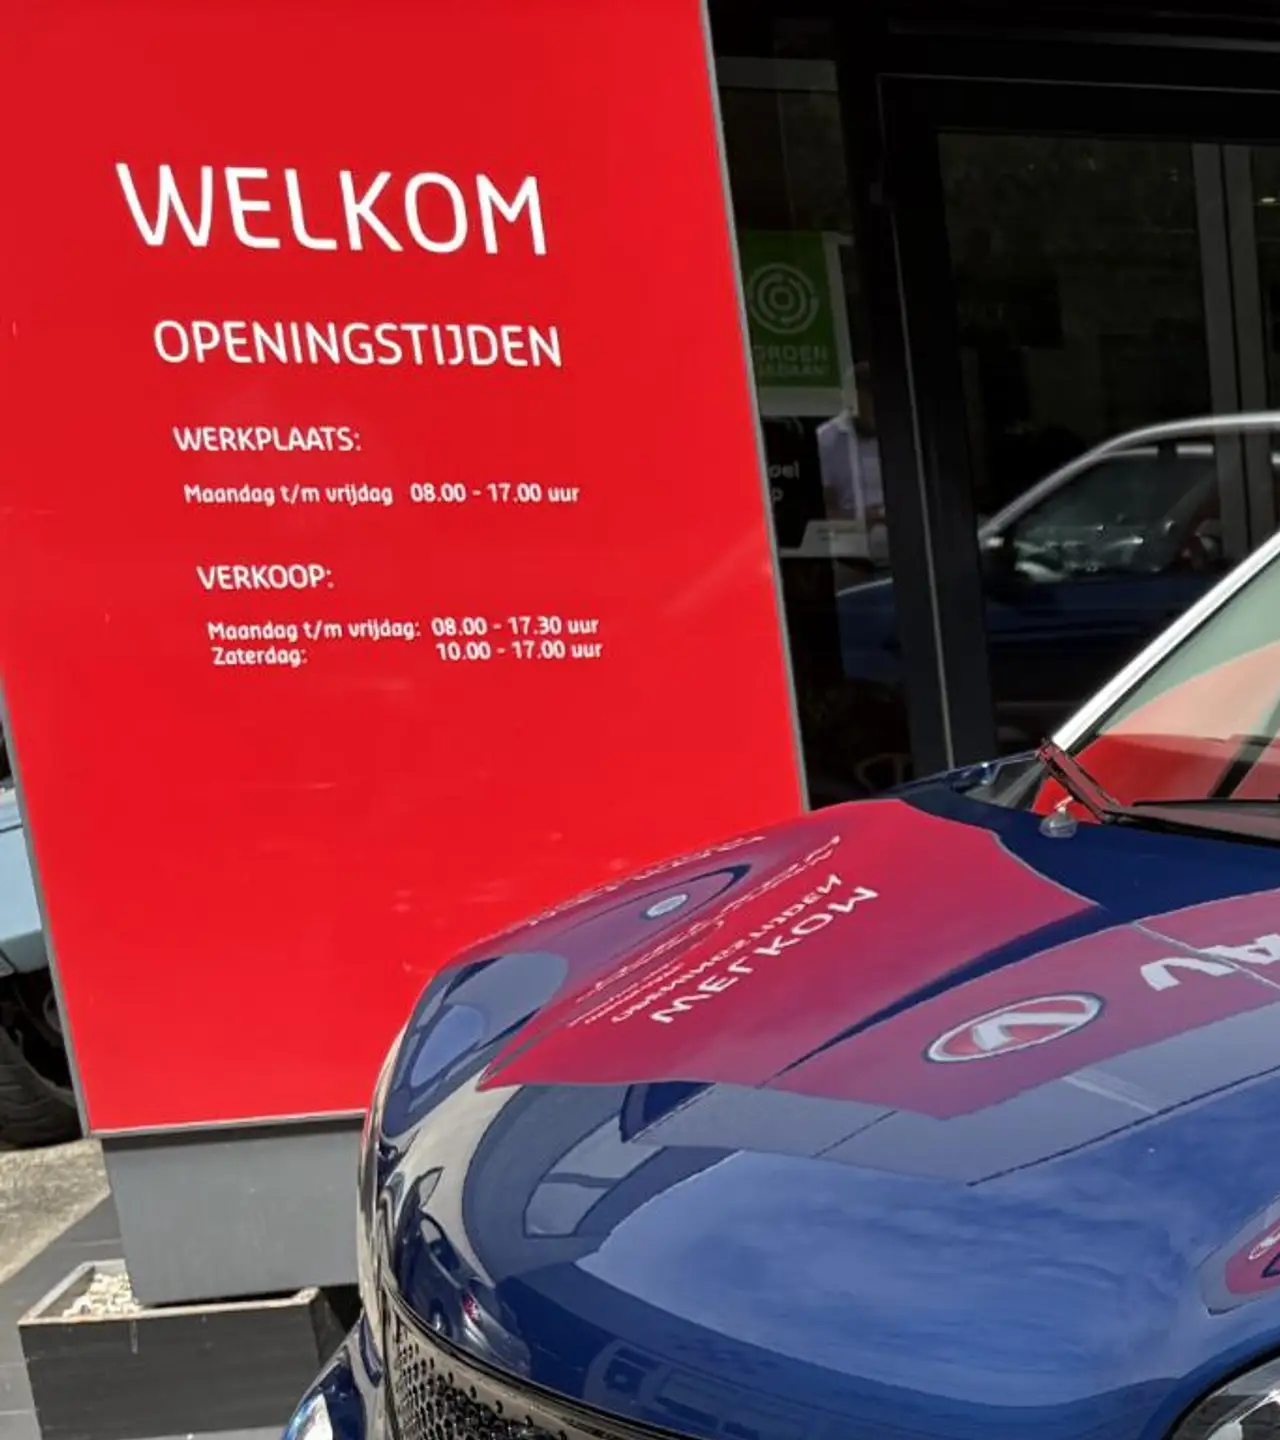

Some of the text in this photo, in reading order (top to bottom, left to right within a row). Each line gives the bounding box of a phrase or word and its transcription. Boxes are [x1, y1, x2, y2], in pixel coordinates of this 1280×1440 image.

[115, 162, 548, 256] WELKOM
[153, 319, 563, 368] OPENINGSTIJDEN
[172, 426, 362, 453] WERKPLAATS:
[183, 483, 276, 507] Maandag
[280, 483, 320, 505] t/m
[325, 483, 394, 507] vrijdag
[410, 482, 467, 502] 08.00
[487, 482, 542, 503] 17.00
[547, 487, 580, 503] uur
[196, 563, 334, 591] VERKOOP:
[207, 620, 298, 643] Maandag
[303, 619, 342, 639] t/m
[348, 619, 421, 642] vrijdag:
[431, 616, 488, 637] 08.00
[507, 616, 563, 637] 17.30
[567, 618, 600, 634] uur
[211, 646, 308, 669] Zaterdag:
[436, 641, 492, 661] 10.00
[512, 640, 566, 660] 17.00
[571, 643, 603, 659] uur
